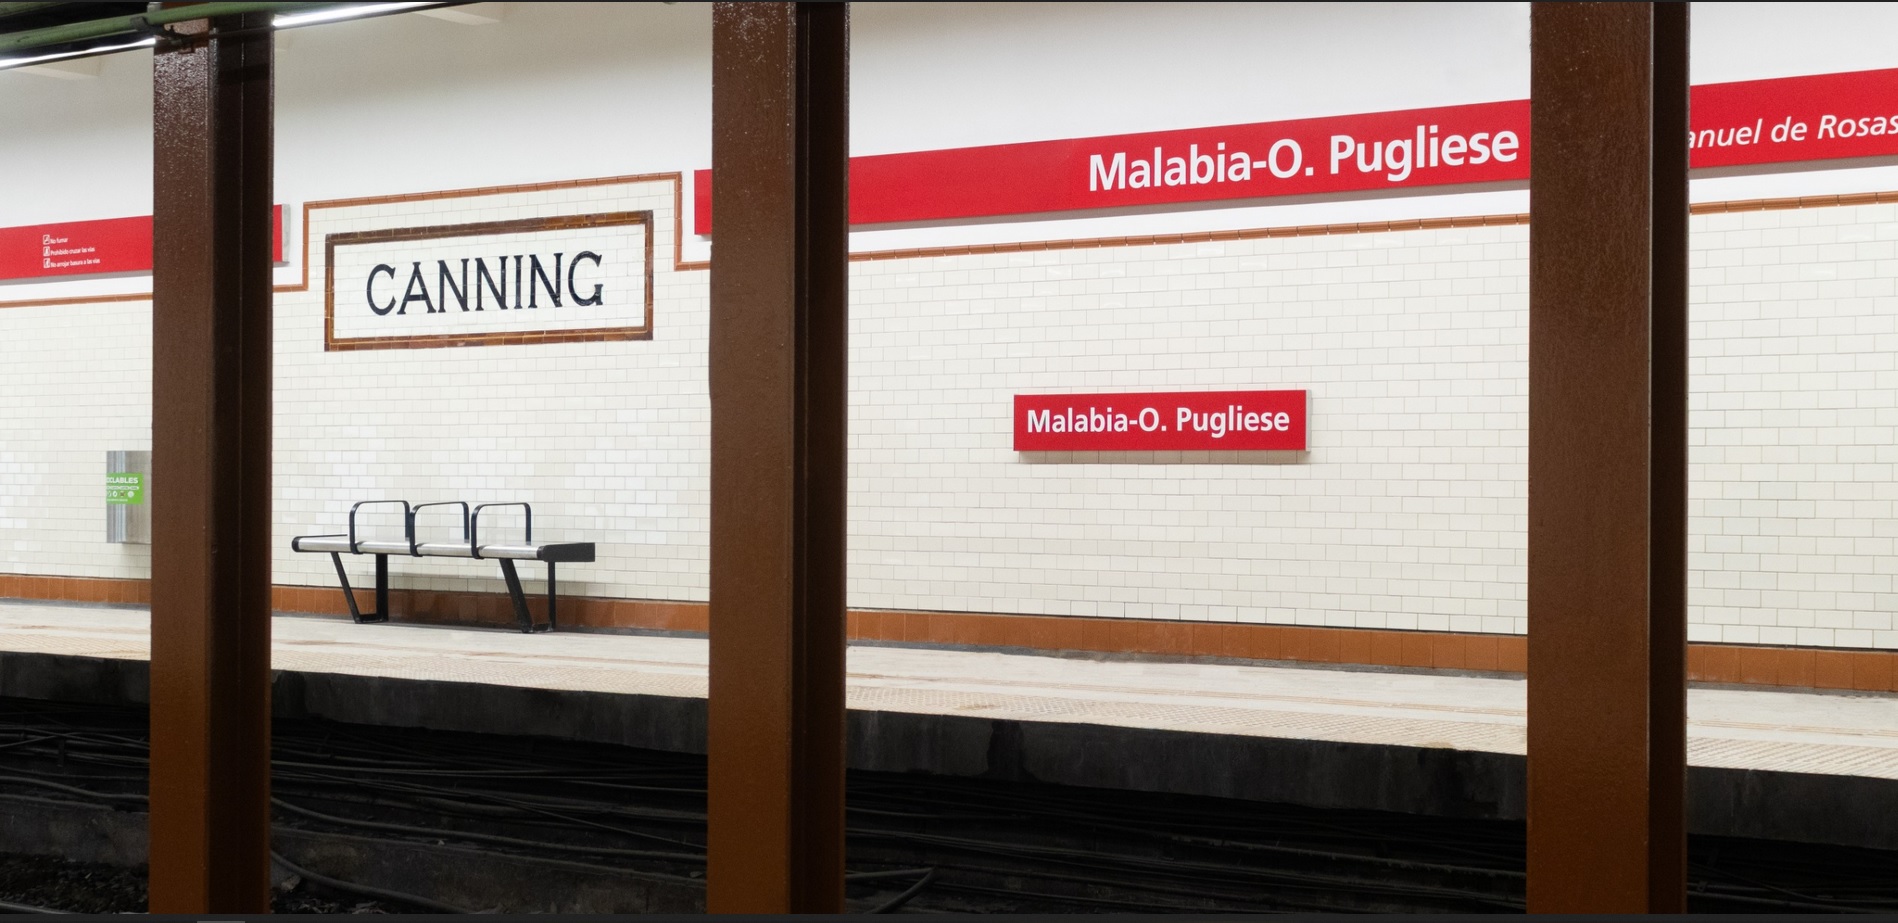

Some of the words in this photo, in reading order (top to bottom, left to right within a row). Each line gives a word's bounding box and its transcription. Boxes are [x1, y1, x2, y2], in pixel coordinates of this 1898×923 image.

[1770, 116, 1808, 143] de
[1817, 114, 1898, 140] Rosas
[1089, 138, 1314, 192] Malabia-O.
[1330, 124, 1520, 182] Pugliese
[366, 250, 604, 316] CANNING
[1027, 406, 1167, 433] Malabia-O.
[1176, 404, 1290, 438] Pugliese
